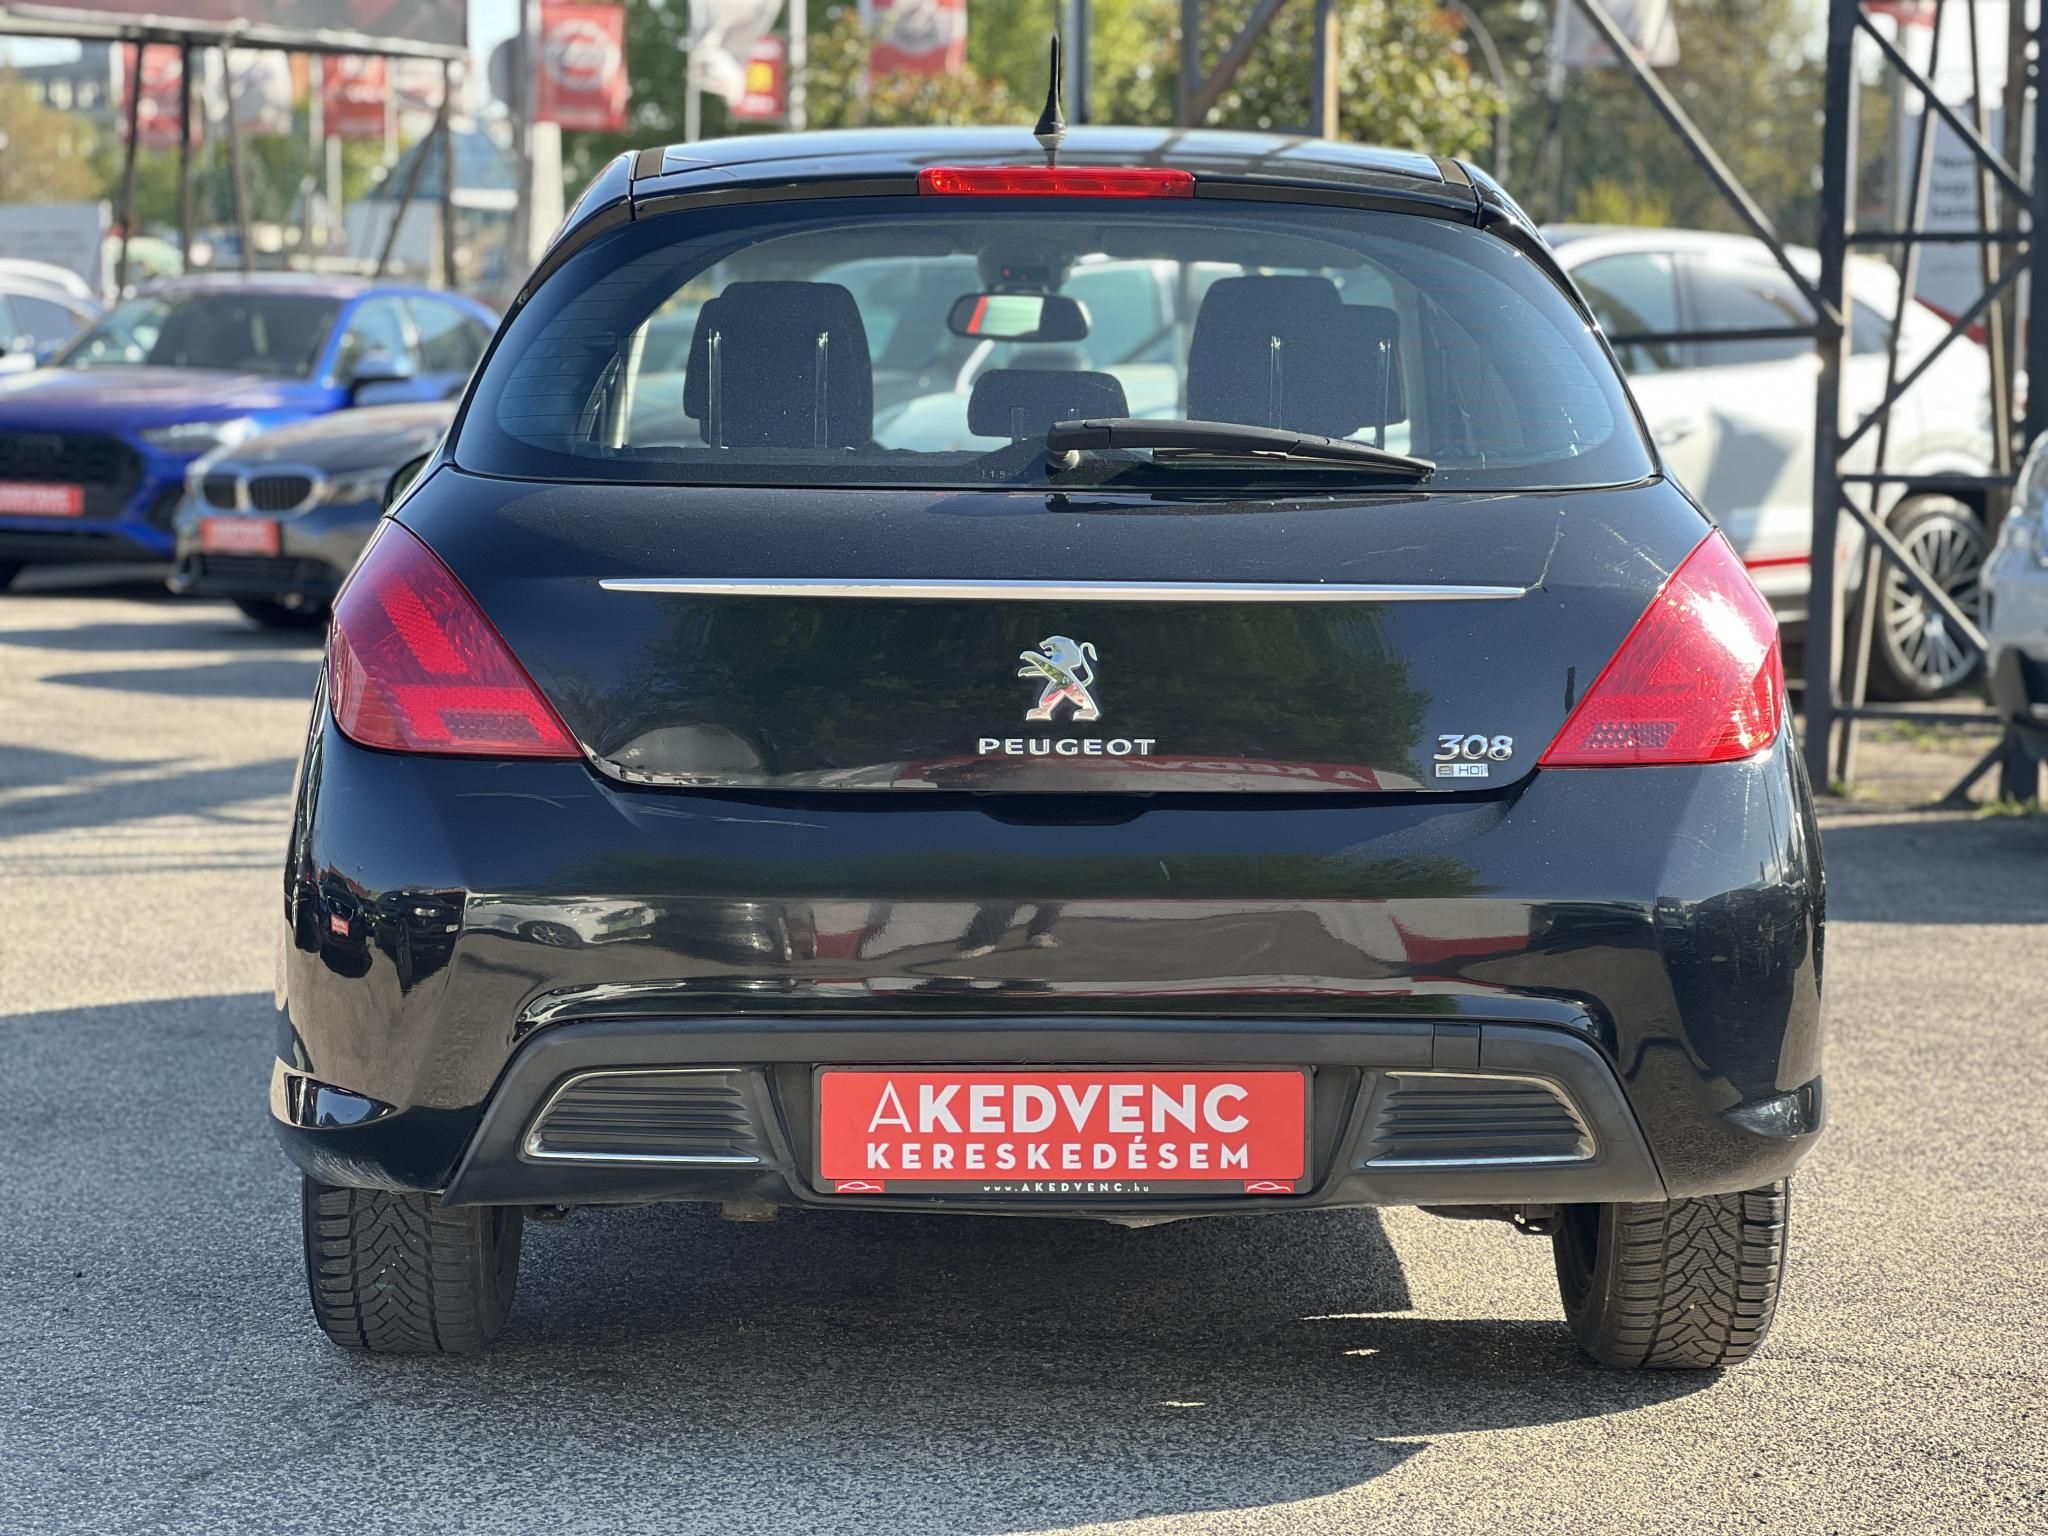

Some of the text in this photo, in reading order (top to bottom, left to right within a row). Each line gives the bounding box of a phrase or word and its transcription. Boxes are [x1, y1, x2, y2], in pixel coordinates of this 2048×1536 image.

[978, 737, 1156, 756] PEUGEOT
[1433, 734, 1513, 761] 308
[867, 1136, 1249, 1170] KERESKEDÉSEM
[983, 1182, 1150, 1193] www.AKEDVENC.hu
